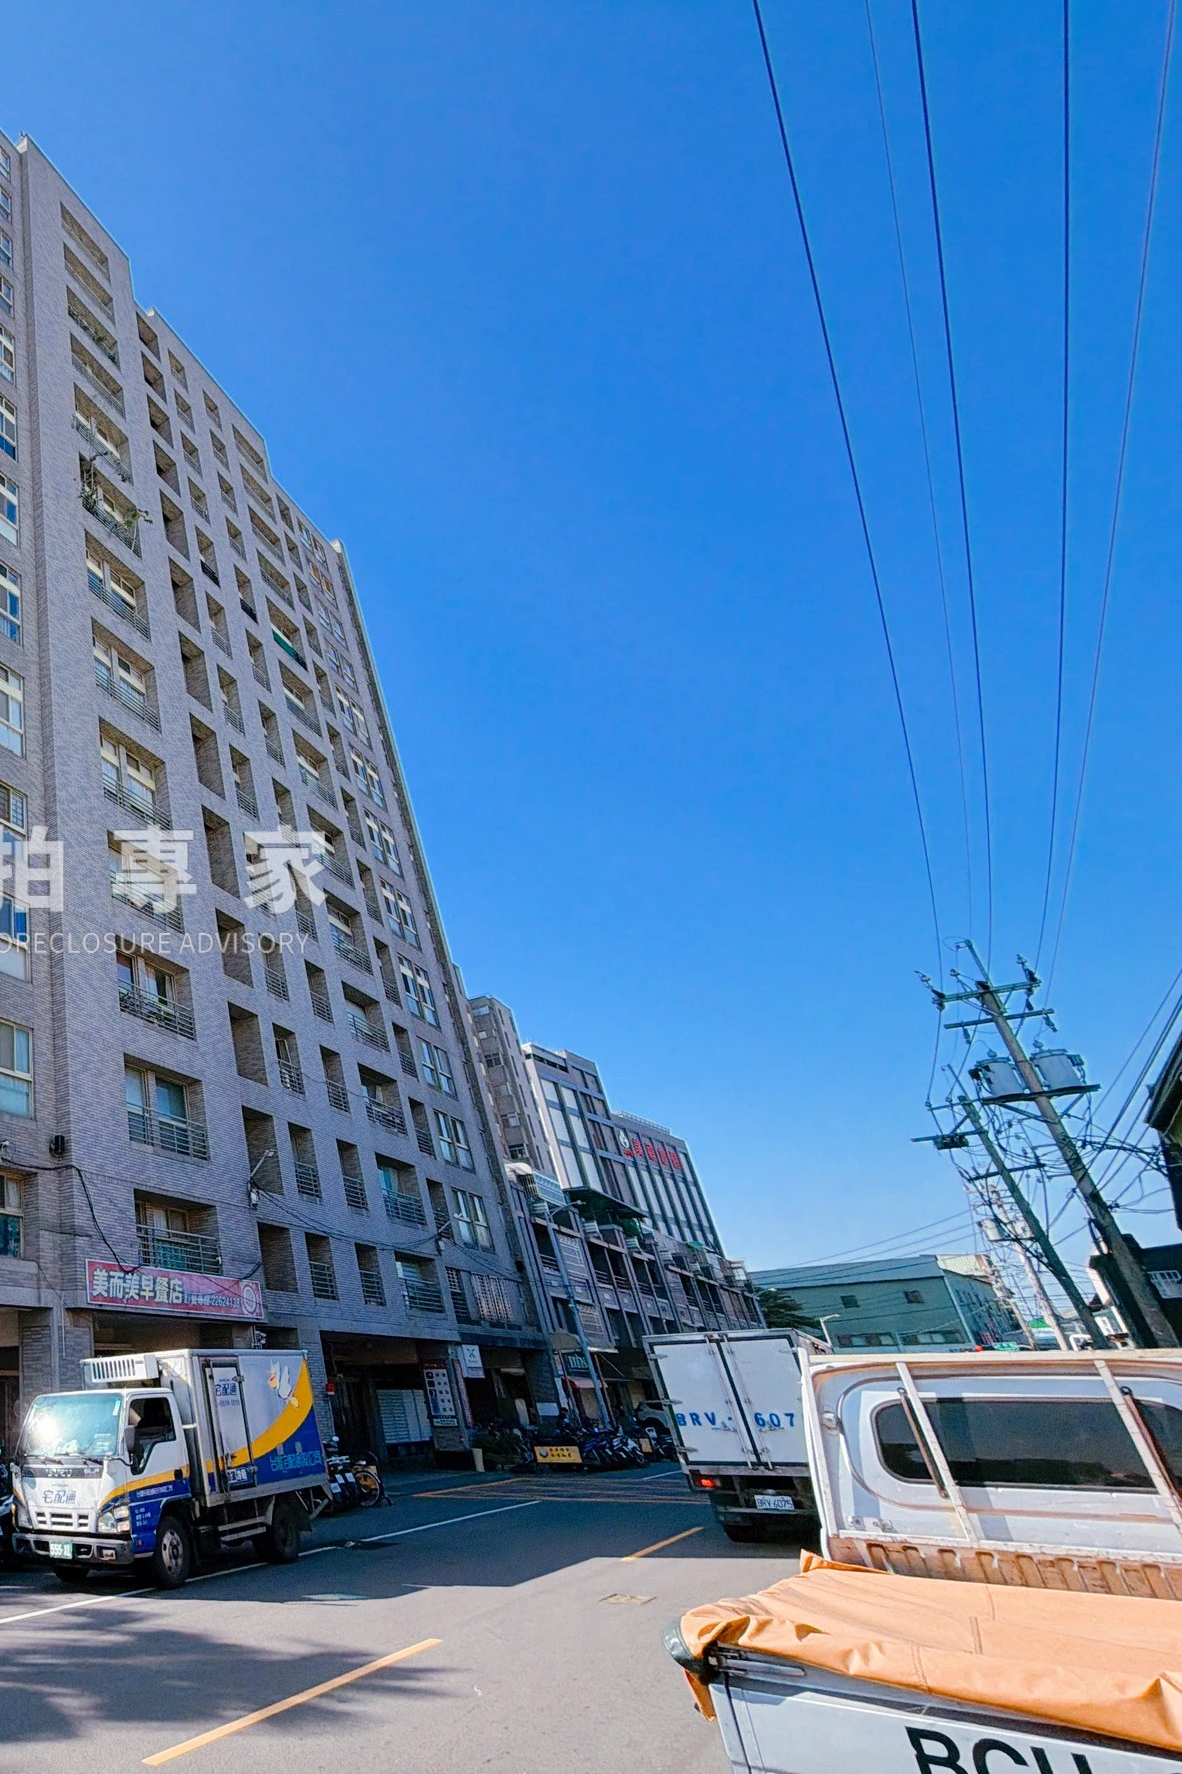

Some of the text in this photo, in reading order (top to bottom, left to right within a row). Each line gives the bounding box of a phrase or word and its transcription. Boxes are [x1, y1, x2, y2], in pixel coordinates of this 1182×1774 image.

[91, 1267, 184, 1305] 美而美早餐店
